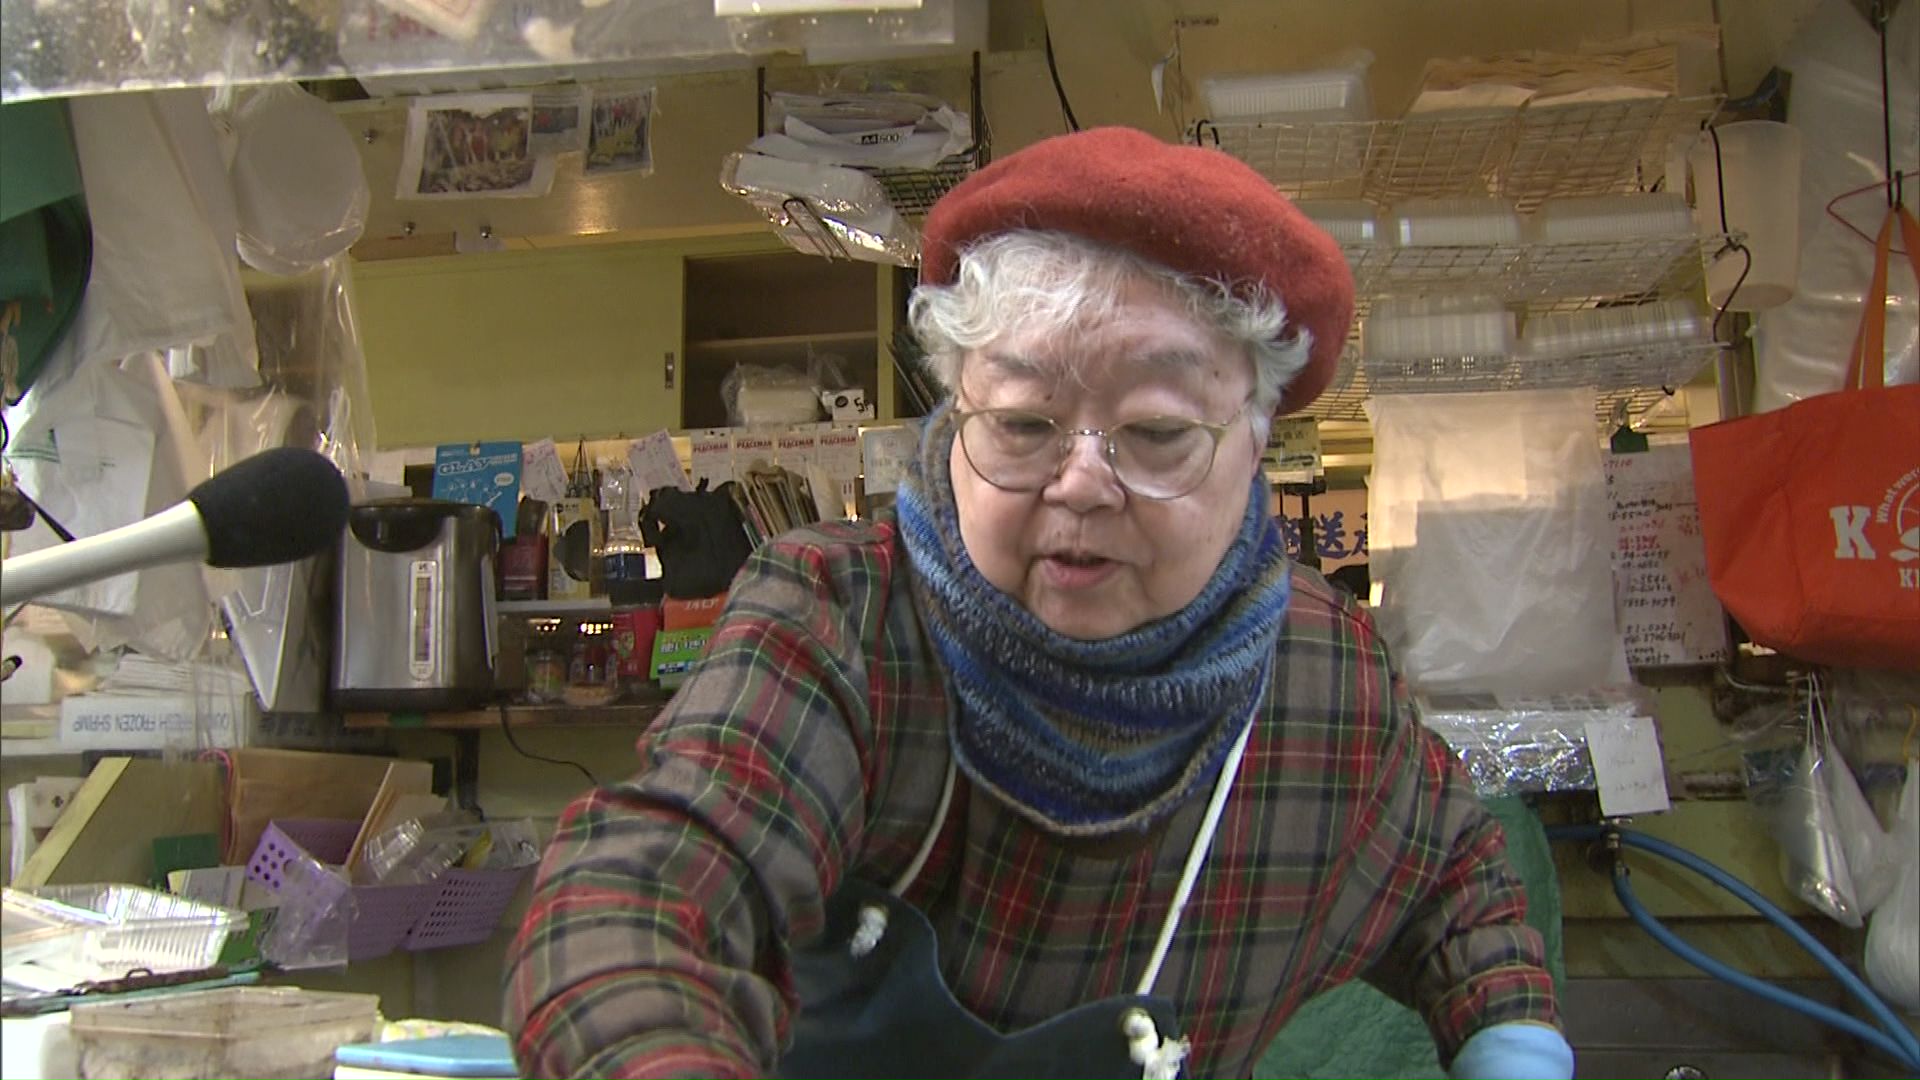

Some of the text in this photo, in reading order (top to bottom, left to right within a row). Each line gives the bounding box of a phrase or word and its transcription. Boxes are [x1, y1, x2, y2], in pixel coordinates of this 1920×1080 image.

[863, 134, 877, 144] A4
[1829, 505, 1876, 559] K
[116, 713, 156, 732] FROZEN
